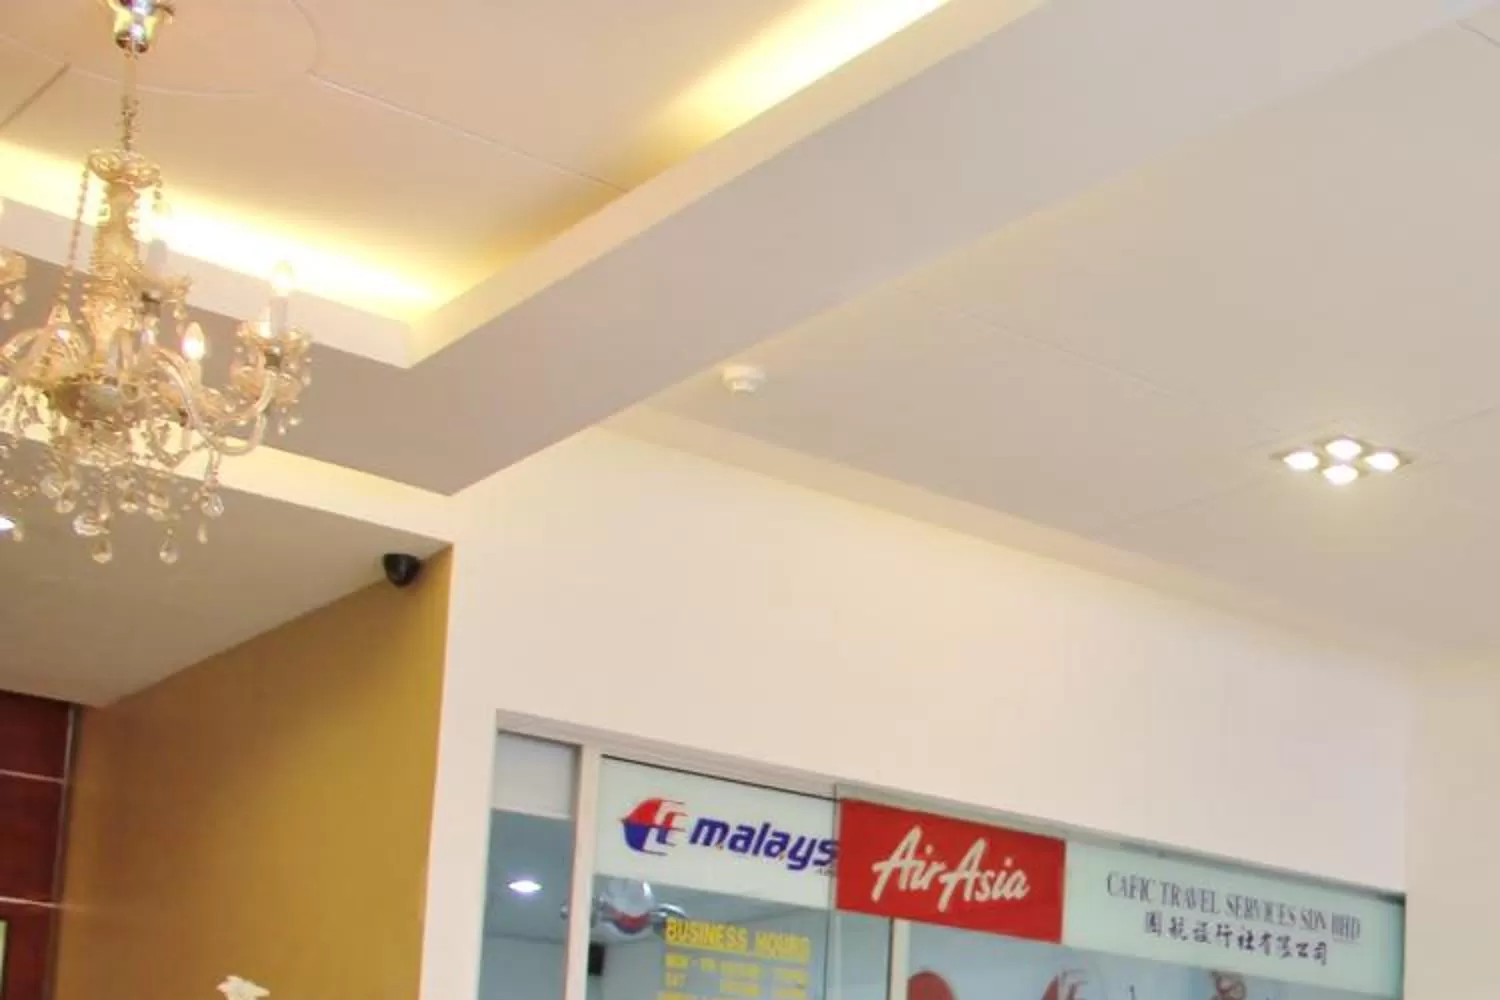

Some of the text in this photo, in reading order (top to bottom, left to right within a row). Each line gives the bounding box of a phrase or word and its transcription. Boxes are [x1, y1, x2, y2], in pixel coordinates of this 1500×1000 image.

[1159, 880, 1221, 915] TRAVEL
[1224, 893, 1297, 928] SERVICES
[665, 917, 749, 956] BUSINESS
